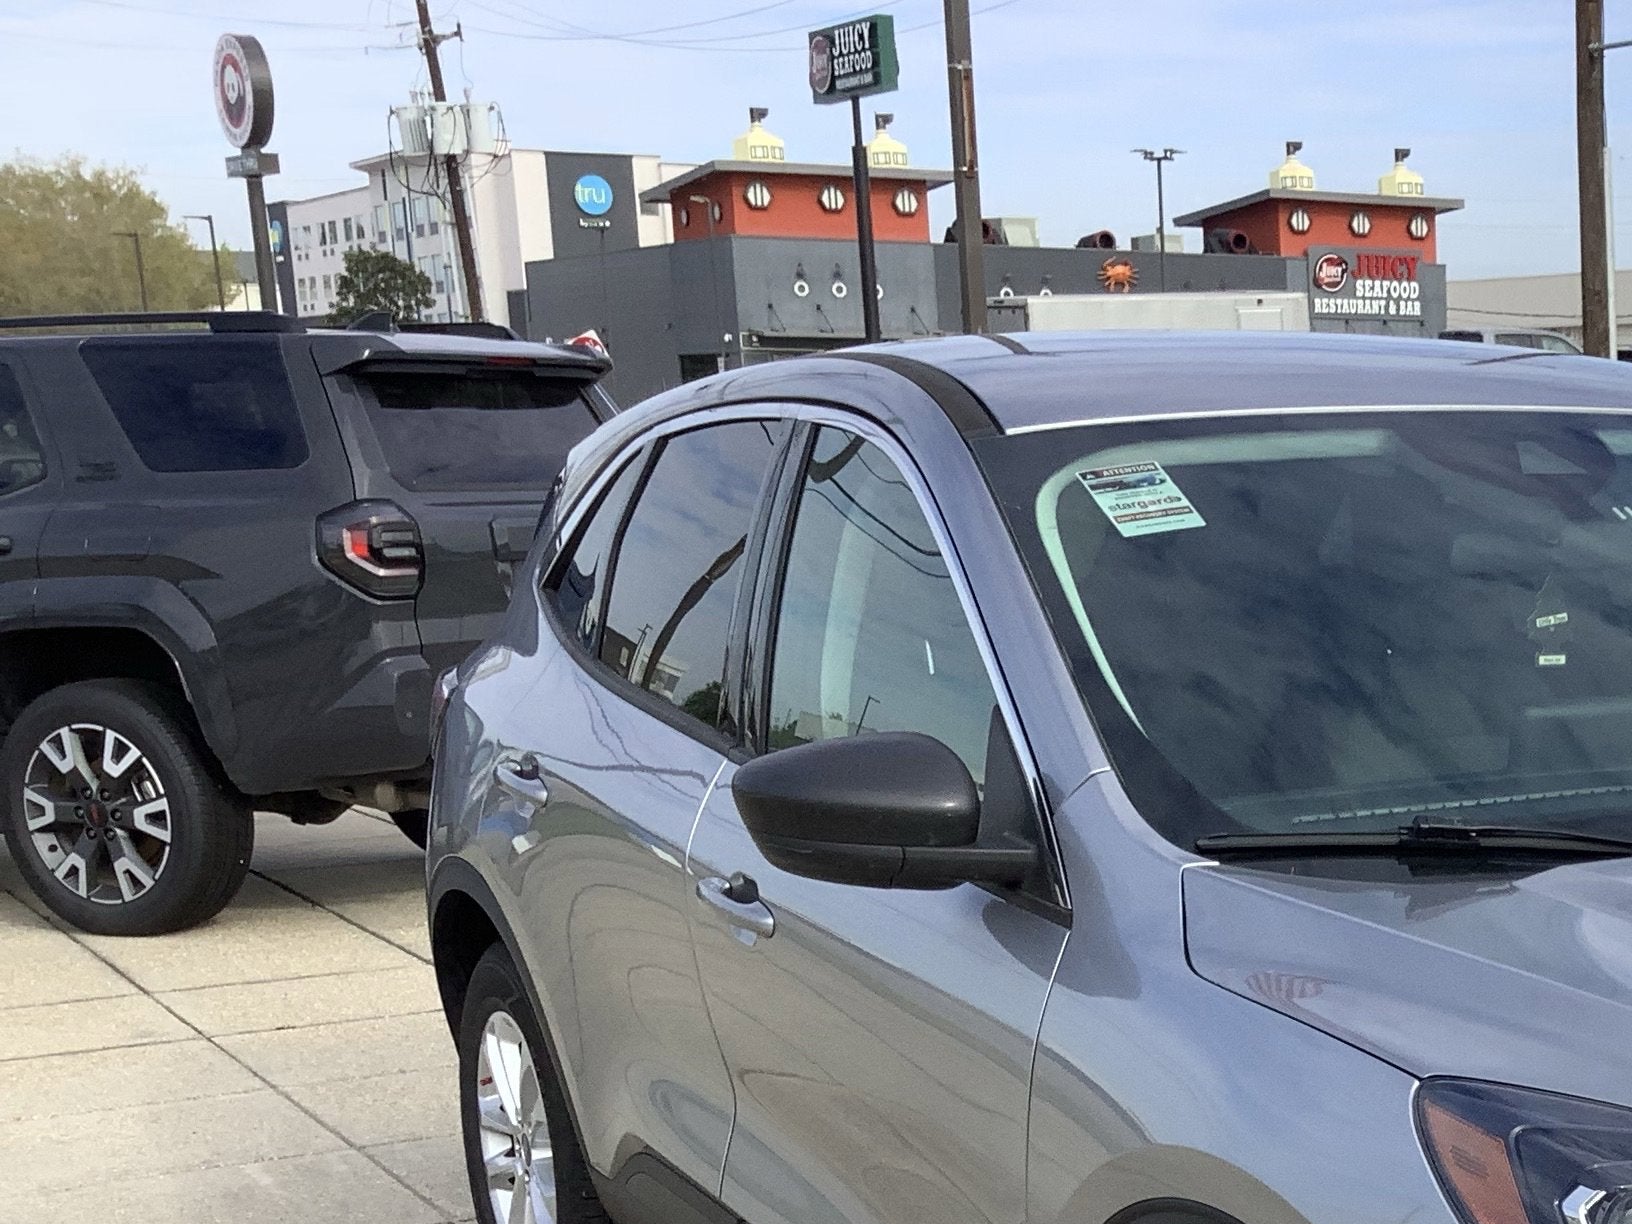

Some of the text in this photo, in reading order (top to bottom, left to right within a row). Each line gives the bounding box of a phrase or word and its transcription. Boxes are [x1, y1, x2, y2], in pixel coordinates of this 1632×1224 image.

[832, 21, 870, 57] JUICY
[833, 50, 873, 76] SEAFOOD
[575, 182, 606, 204] tru
[1351, 254, 1418, 281] JUICY
[1355, 280, 1420, 298] SEAFOOD
[1314, 298, 1421, 316] RESTAURANT & BAR
[1103, 463, 1155, 477] ATTENTION
